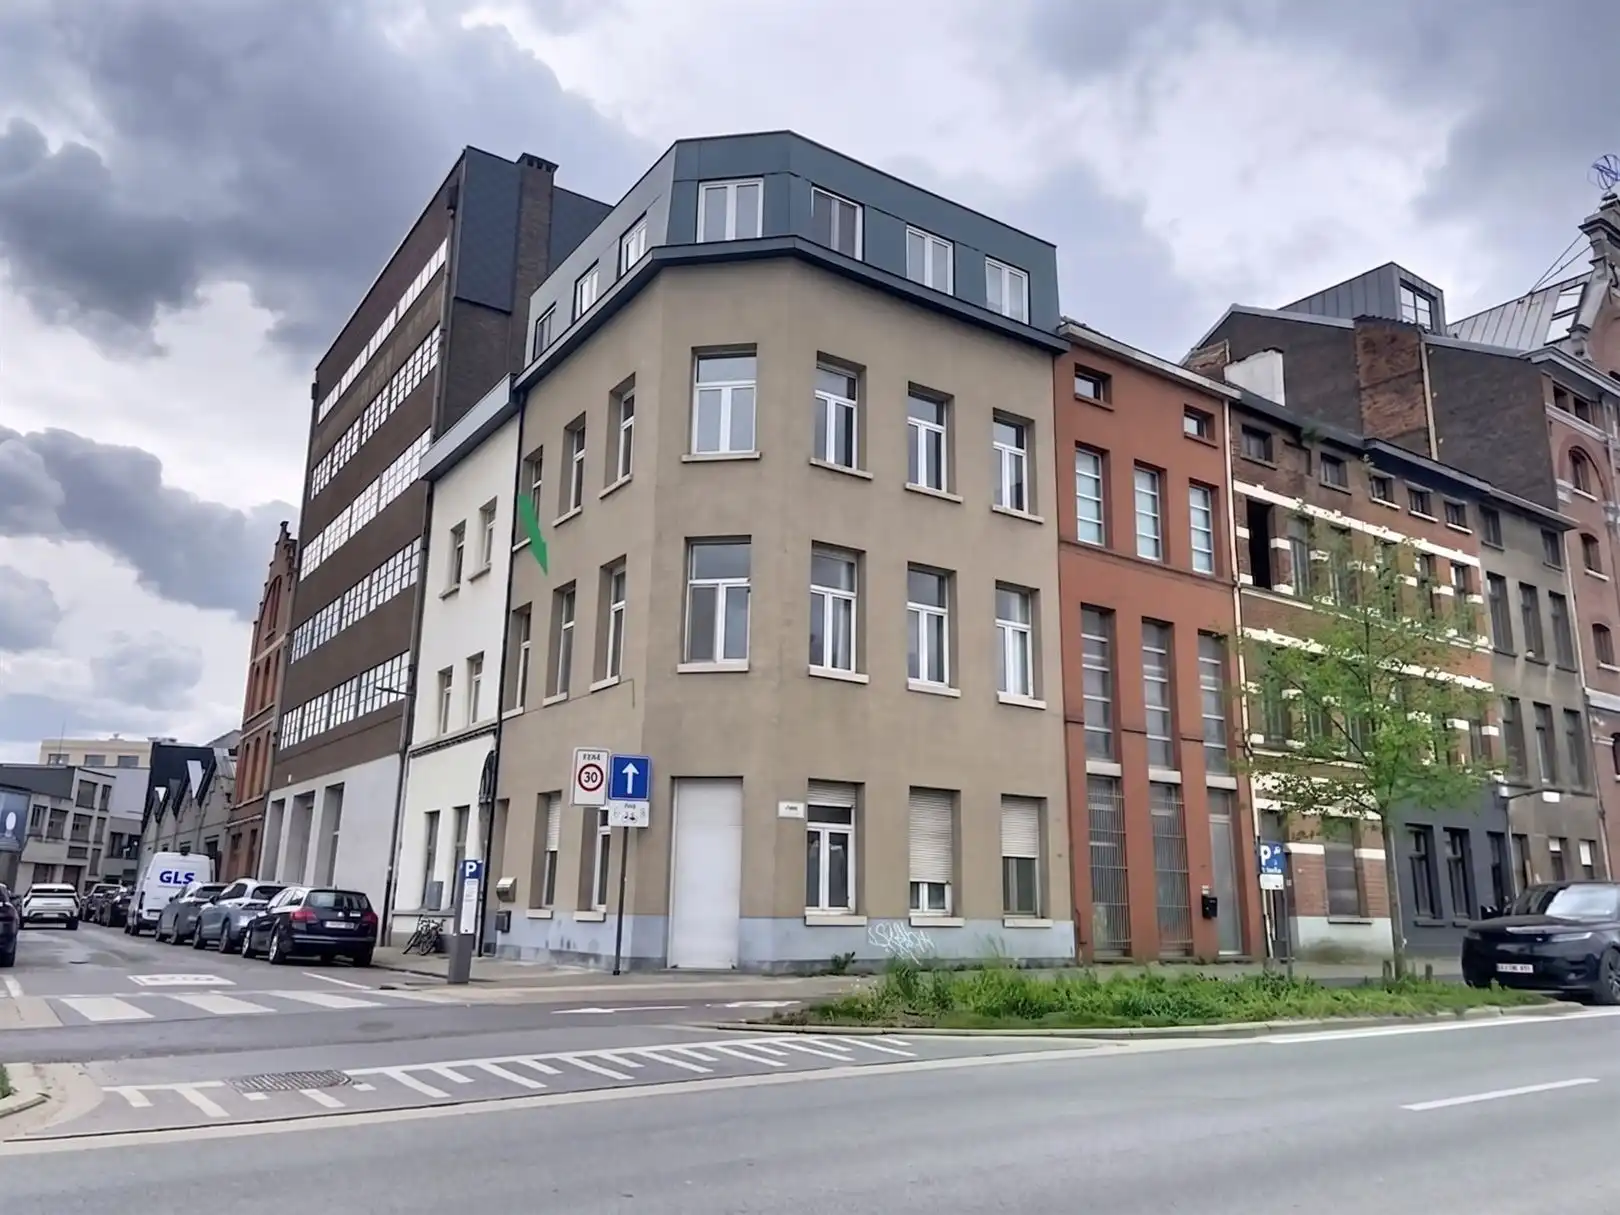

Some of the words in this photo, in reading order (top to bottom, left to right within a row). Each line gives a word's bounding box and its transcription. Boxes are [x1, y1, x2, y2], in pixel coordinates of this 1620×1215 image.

[584, 772, 598, 783] 30
[1260, 844, 1271, 866] P
[465, 861, 477, 877] P
[159, 870, 195, 885] GLS
